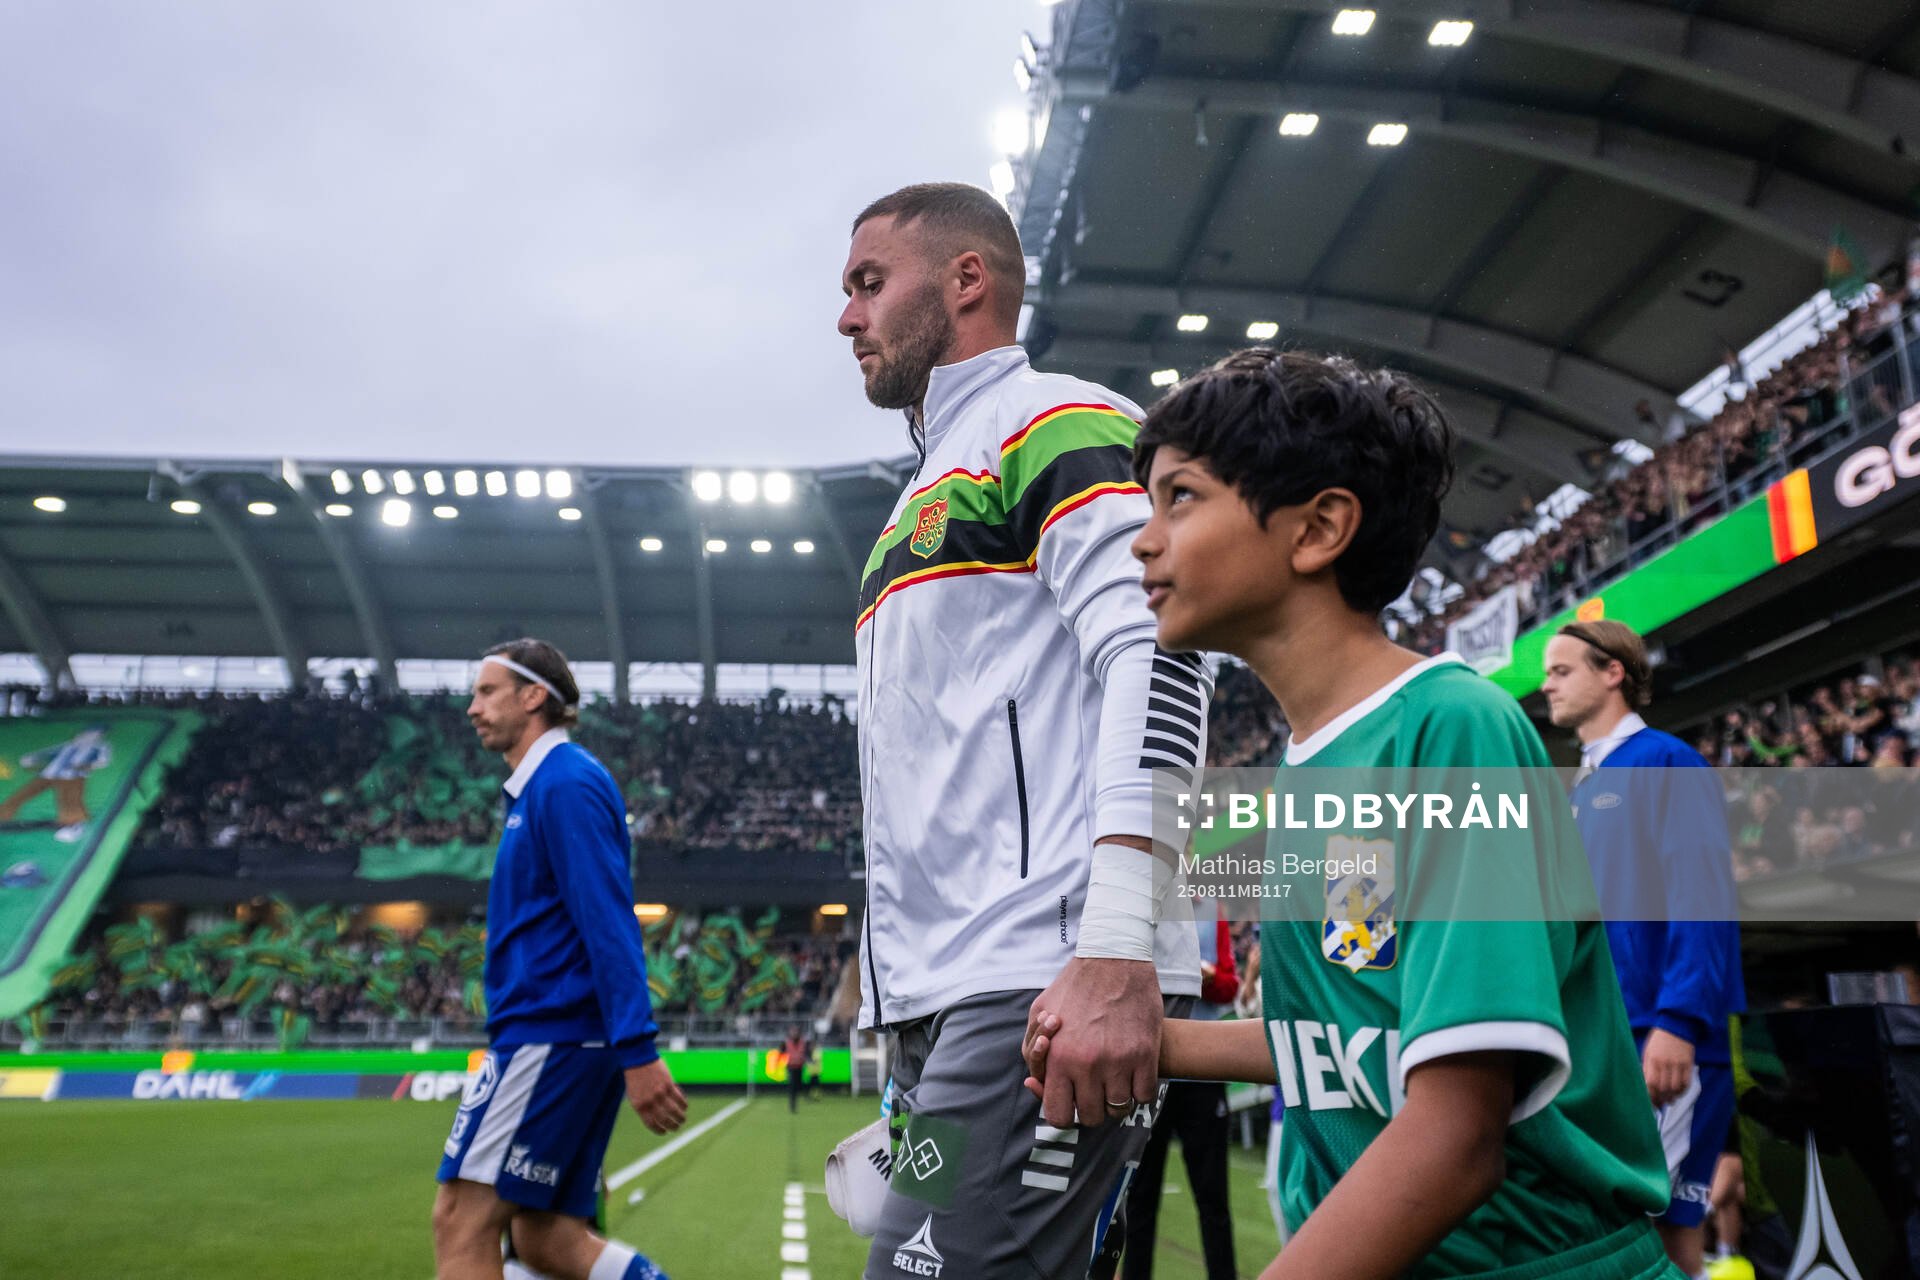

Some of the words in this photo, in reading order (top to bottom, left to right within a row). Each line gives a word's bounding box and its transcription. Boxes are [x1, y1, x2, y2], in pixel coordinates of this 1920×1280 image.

[132, 1069, 243, 1098] DAHL
[503, 1157, 560, 1187] RASTA
[892, 1250, 943, 1278] SELECT
